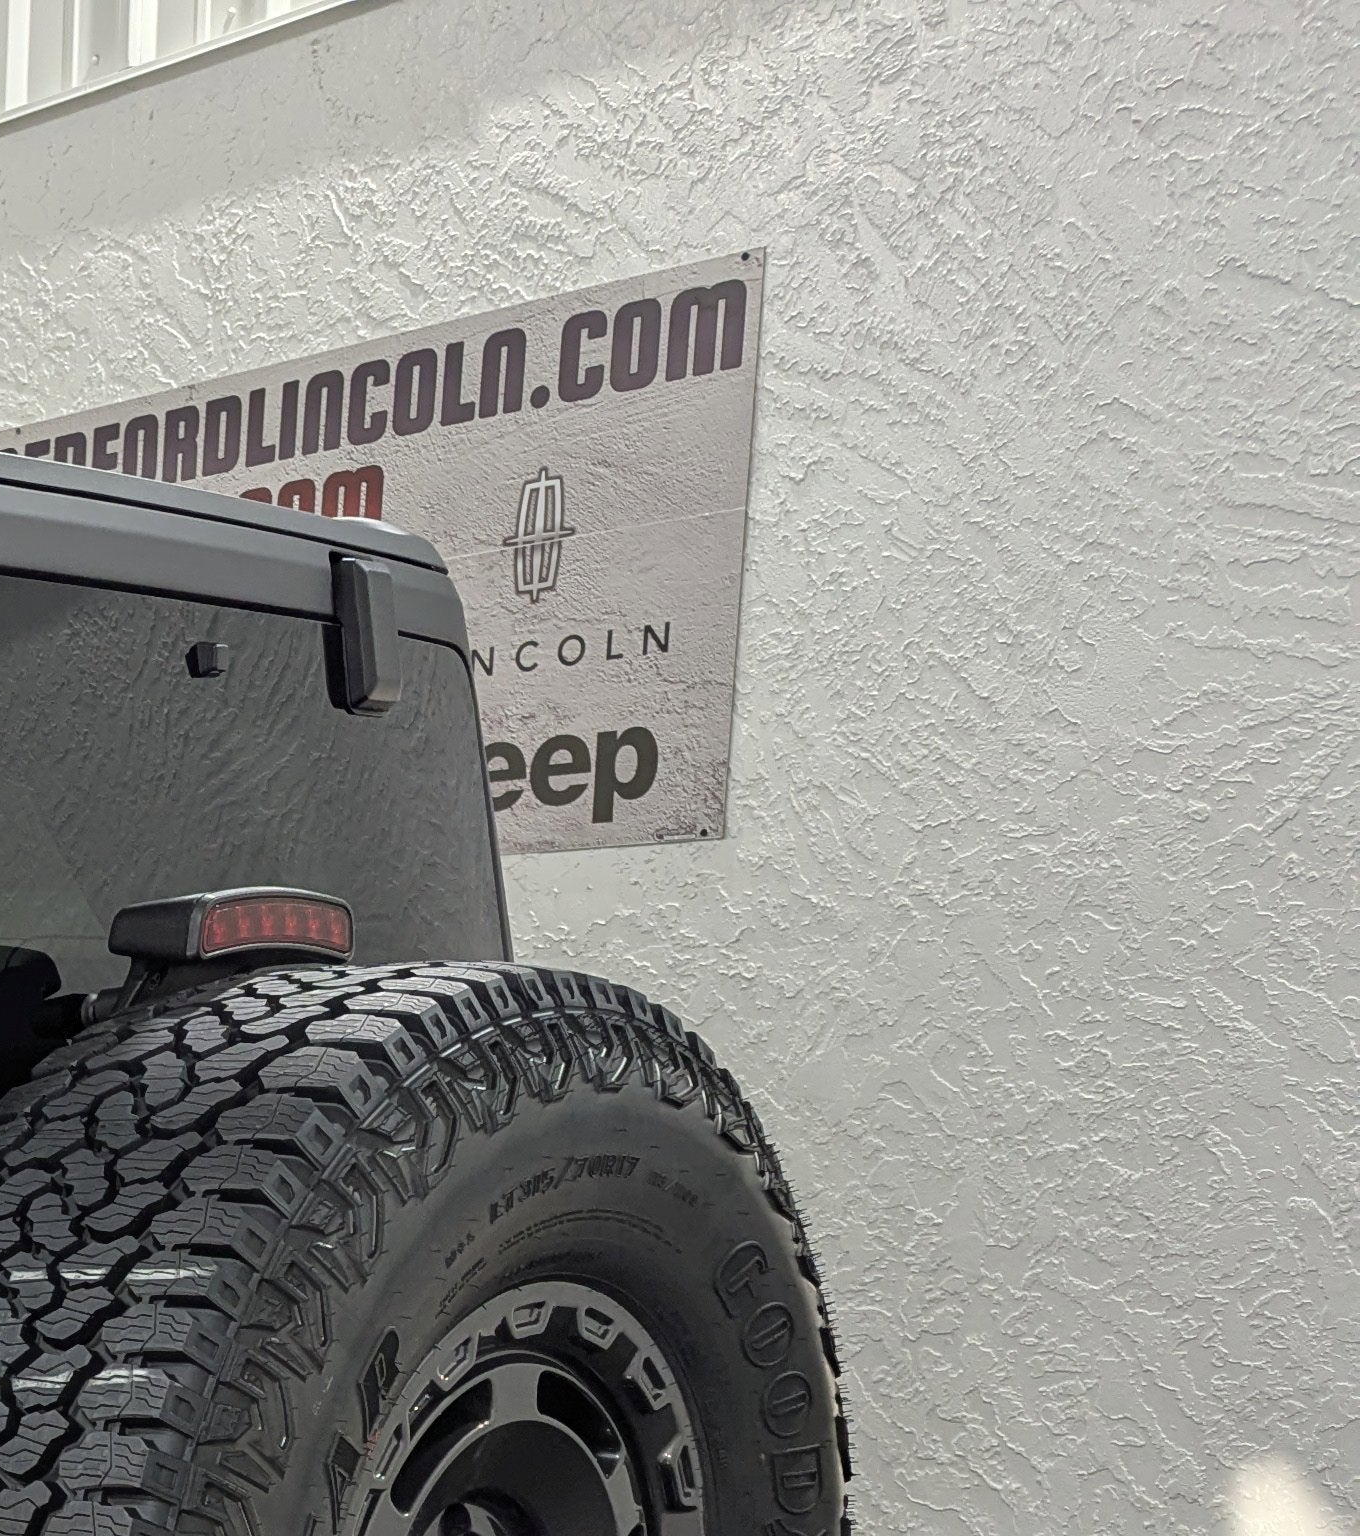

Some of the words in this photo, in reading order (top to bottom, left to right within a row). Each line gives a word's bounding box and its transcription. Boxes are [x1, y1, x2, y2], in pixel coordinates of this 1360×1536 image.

[0, 279, 747, 483] FORDLINCOLN.COM
[472, 622, 670, 676] NCOLN
[485, 727, 659, 824] eep
